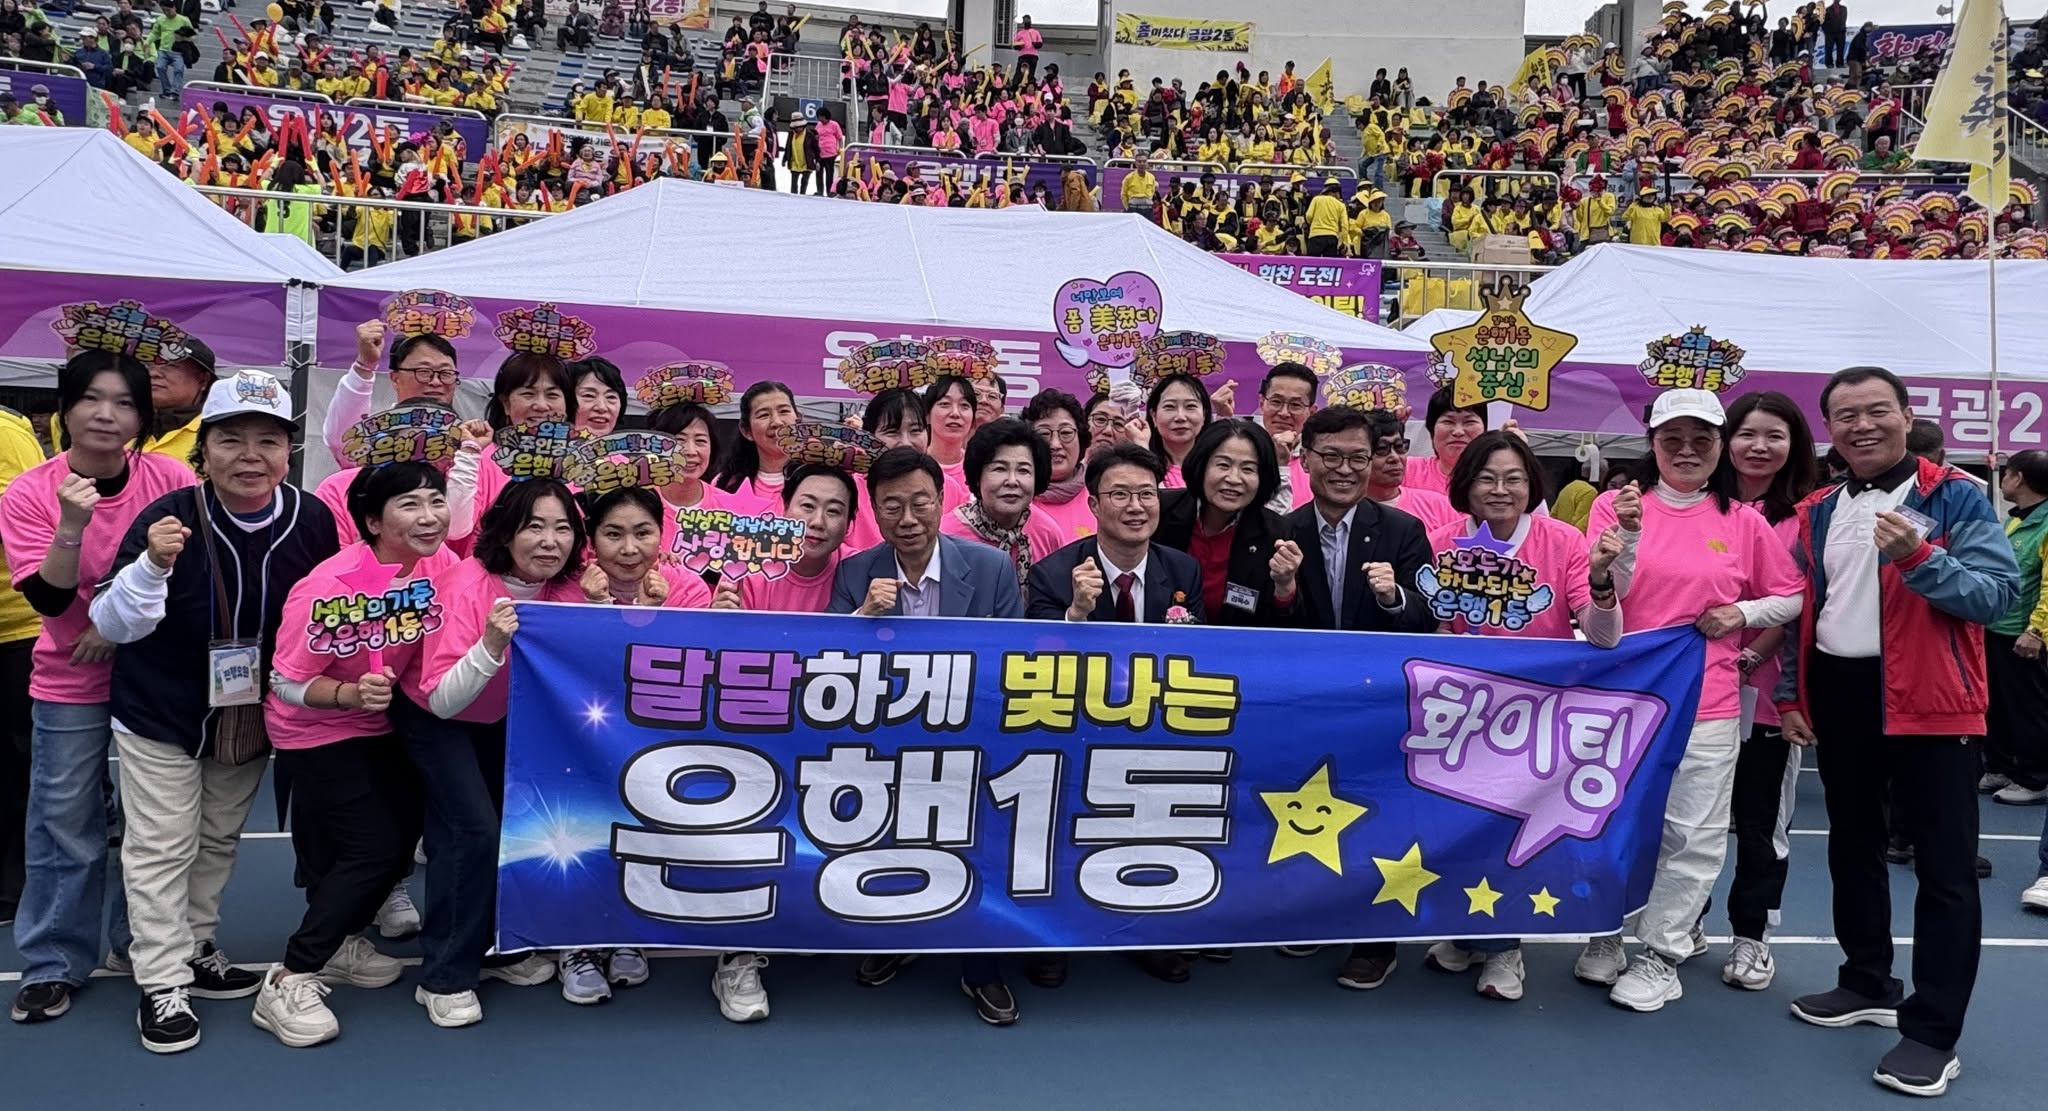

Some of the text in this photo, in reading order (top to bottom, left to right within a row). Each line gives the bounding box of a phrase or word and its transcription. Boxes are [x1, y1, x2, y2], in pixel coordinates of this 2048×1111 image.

[1187, 28, 1235, 42] 금광2동
[805, 102, 817, 118] 6
[1258, 264, 1295, 285] 힘찬
[1298, 266, 1343, 287] 도전!
[1071, 287, 1123, 303] 너만보여
[85, 313, 161, 341] 주인공은
[111, 306, 147, 324] 오늘
[403, 311, 461, 338] 은행1동
[534, 310, 561, 323] 오늘
[1064, 308, 1083, 333] 폼
[517, 320, 575, 340] 주인공은
[1098, 331, 1144, 351] 은행1동
[1475, 325, 1531, 346] 은행1동
[1681, 333, 1711, 350] 오늘
[77, 328, 158, 361] 은행1동
[515, 333, 574, 359] 은행1동
[935, 356, 987, 379] 은행1동
[1157, 351, 1215, 376] 은행1동
[1465, 346, 1539, 371] 성남의
[1664, 347, 1723, 368] 주인공은
[866, 363, 928, 391] 은행1동
[1477, 370, 1524, 398] 중심
[1658, 364, 1722, 391] 은행1동
[660, 383, 721, 406] 은행1동
[1346, 385, 1398, 411] 은행1동
[539, 422, 570, 438] 오늘
[371, 431, 447, 464] 은행1동
[803, 441, 872, 473] 은행1동
[513, 453, 563, 478] 은행1
[596, 456, 673, 488] 은행1동
[1452, 551, 1522, 576] 모두가
[1438, 568, 1532, 600] 하나되는
[313, 580, 435, 627] 성남의 기준
[1431, 589, 1531, 629] 은행1동
[333, 611, 422, 654] 은행1동
[627, 643, 1240, 732] 달달하게 빛나는
[1406, 676, 1628, 809] 화이팅
[612, 742, 1236, 924] 은행1동
